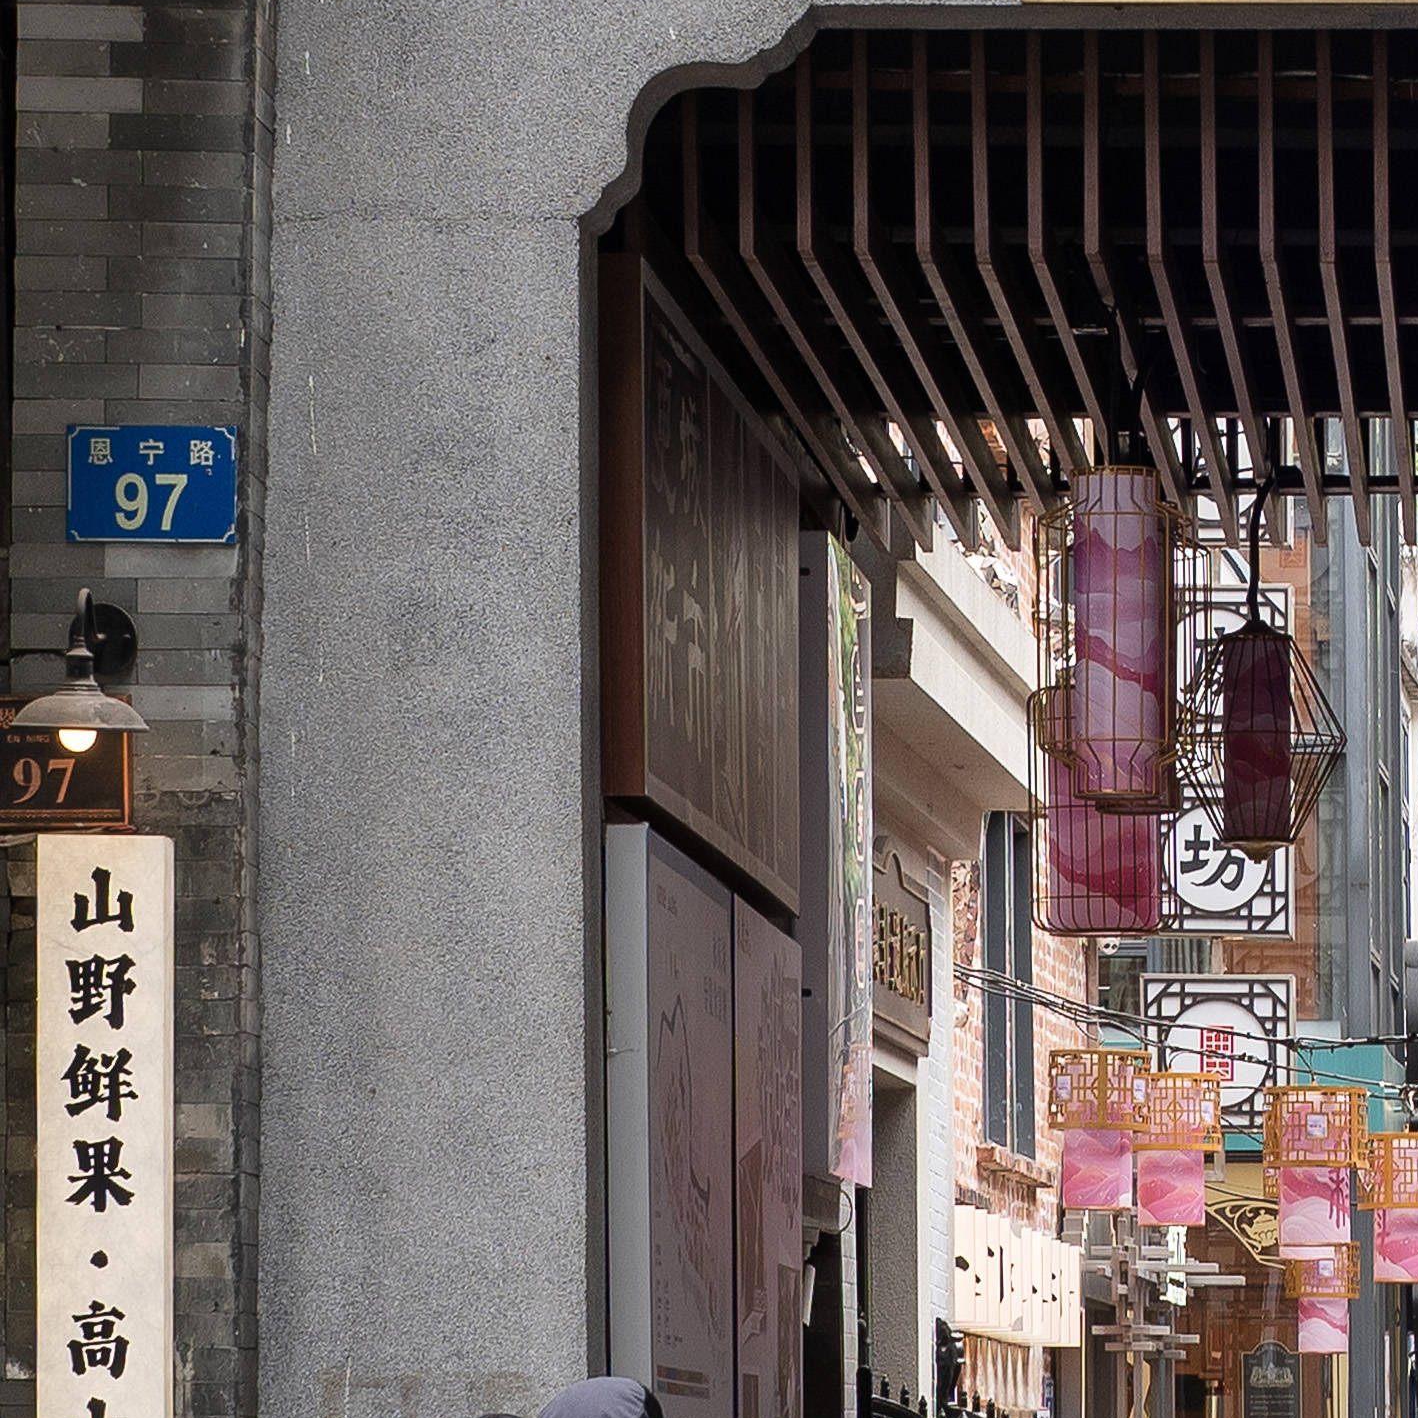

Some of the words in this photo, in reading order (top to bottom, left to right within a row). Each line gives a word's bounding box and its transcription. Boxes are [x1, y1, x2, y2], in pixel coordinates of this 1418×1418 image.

[88, 438, 215, 466] 恩宁路
[114, 472, 188, 531] 97
[13, 757, 75, 804] 97
[1180, 824, 1246, 891] 坊
